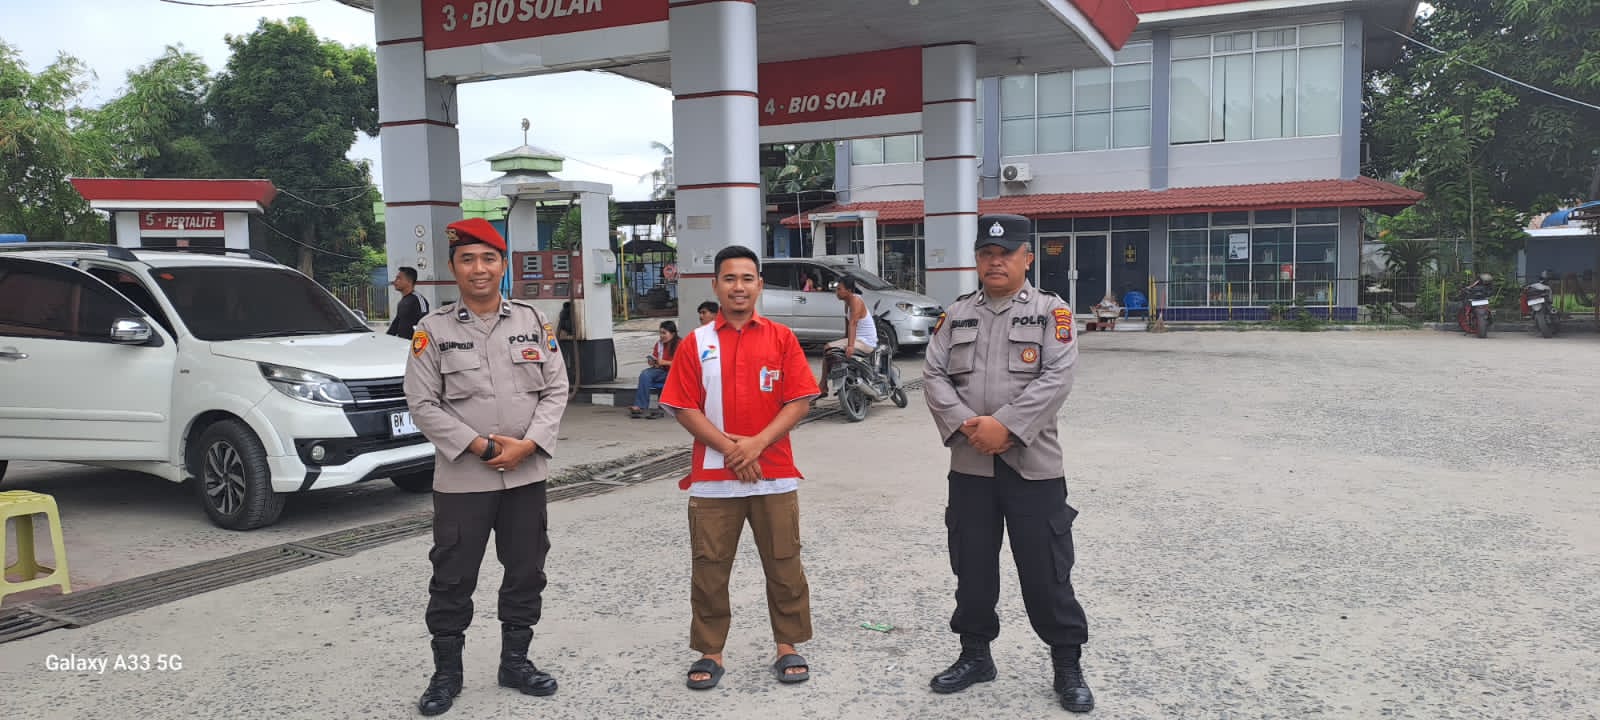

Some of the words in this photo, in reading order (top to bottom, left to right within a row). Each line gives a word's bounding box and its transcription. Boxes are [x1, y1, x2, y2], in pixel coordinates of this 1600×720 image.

[442, 5, 457, 31] 3
[471, 0, 516, 29] BIO
[764, 98, 776, 115] 4
[788, 93, 820, 113] BIO
[823, 87, 886, 110] SOLAR
[145, 213, 154, 226] 5
[165, 216, 216, 228] PERTALITE
[393, 414, 405, 428] BK
